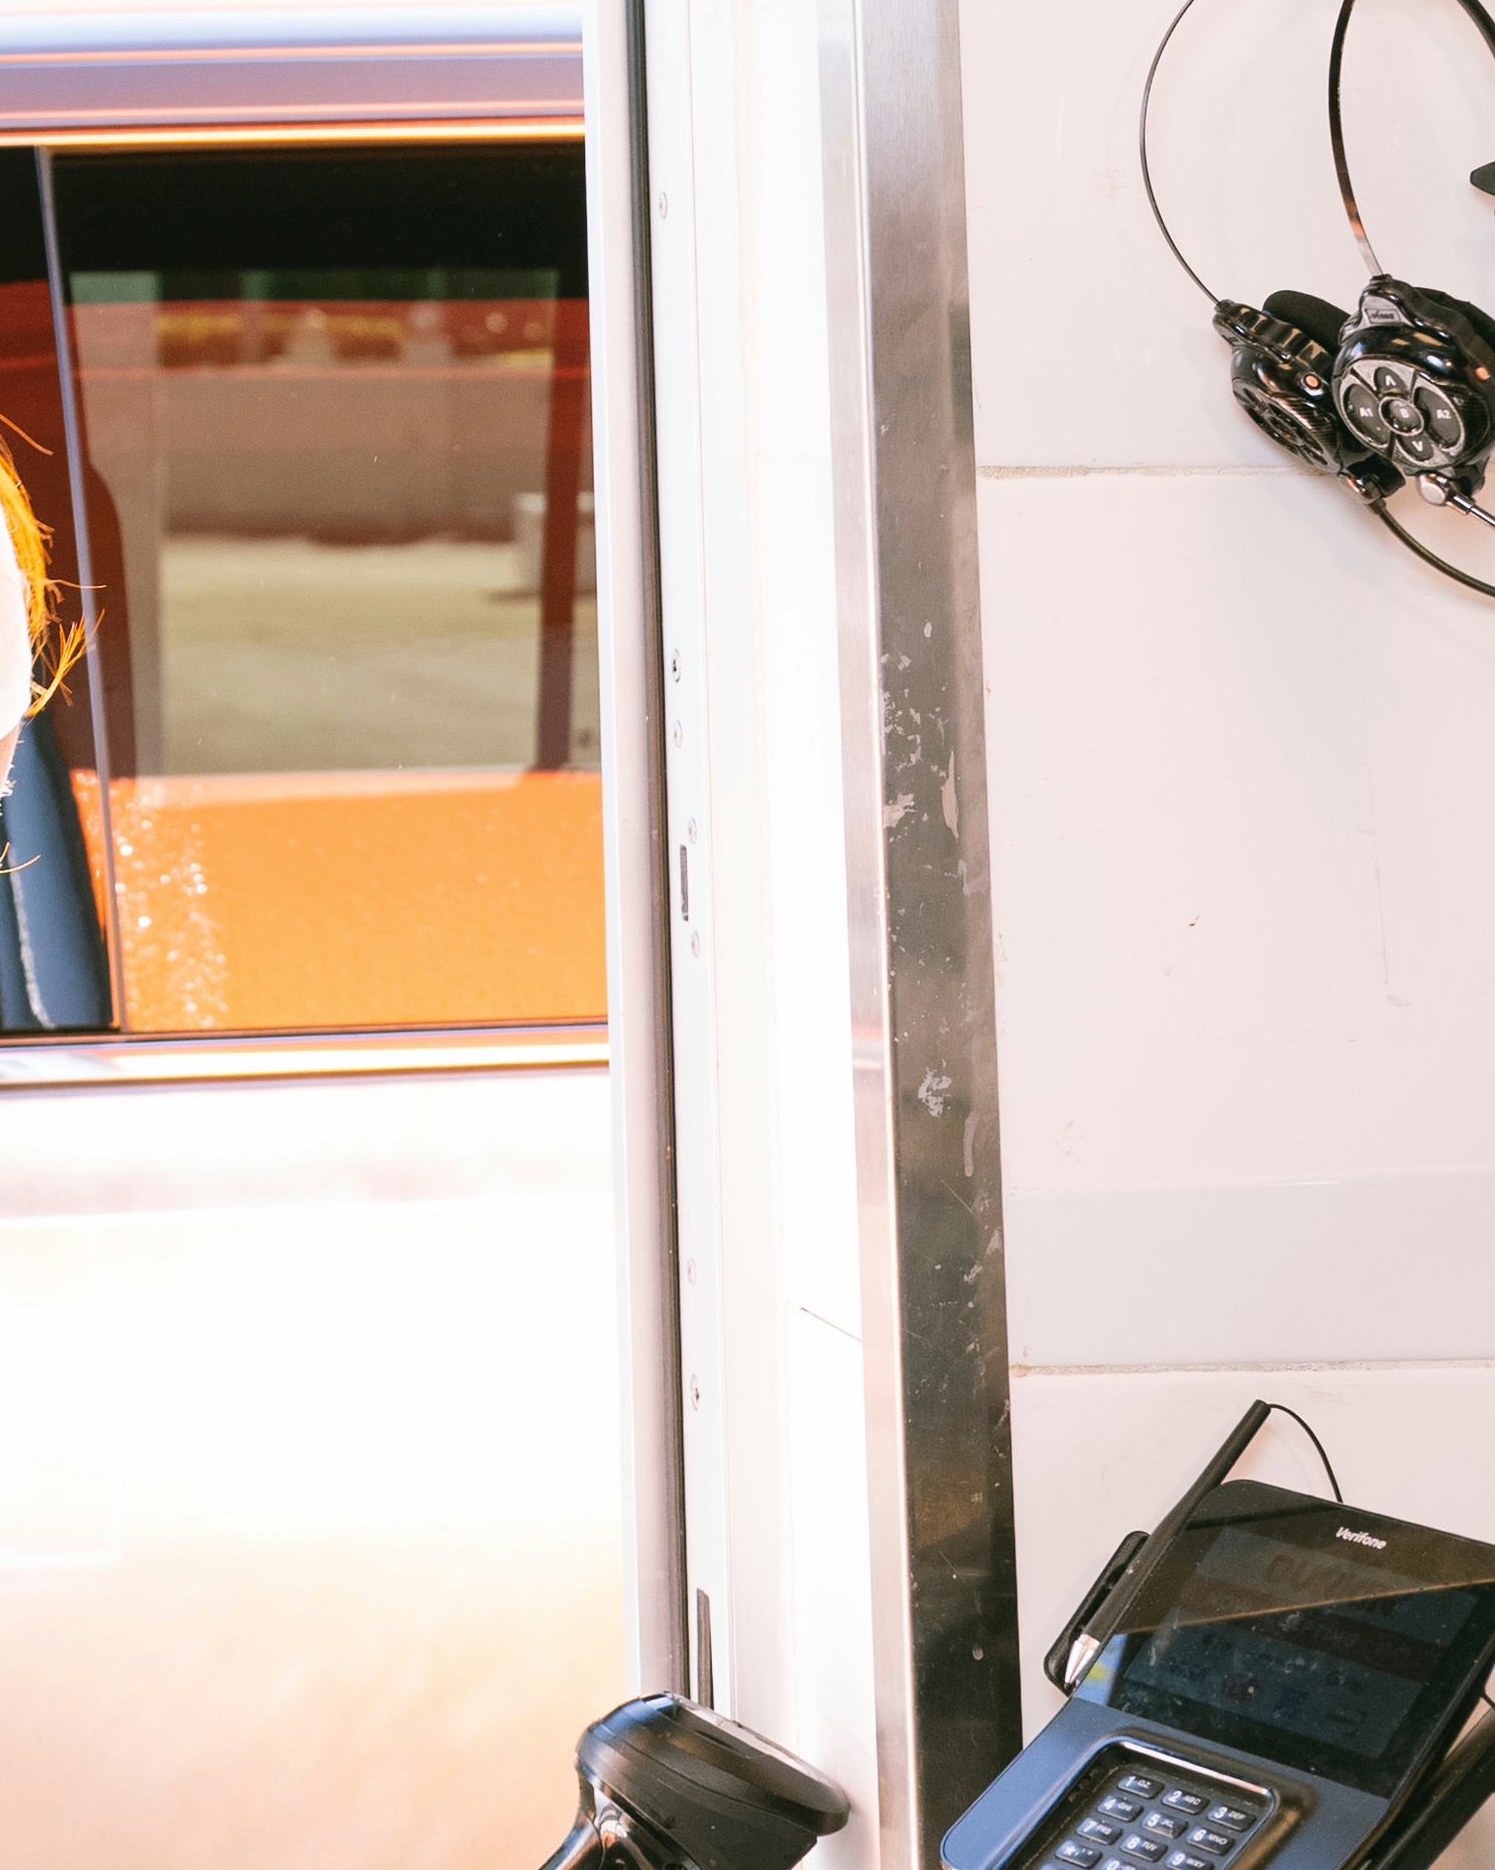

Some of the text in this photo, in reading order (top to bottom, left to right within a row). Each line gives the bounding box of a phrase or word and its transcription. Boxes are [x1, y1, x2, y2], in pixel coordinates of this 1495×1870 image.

[1335, 1526, 1388, 1550] Verifone
[1126, 1775, 1137, 1787] 1
[1170, 1790, 1183, 1803] 2
[1104, 1798, 1117, 1810] 4
[1215, 1806, 1228, 1818] 3
[1148, 1814, 1160, 1826] 5
[1084, 1821, 1097, 1832] 7
[1193, 1828, 1204, 1841] 6
[1128, 1836, 1140, 1849] 8
[1174, 1852, 1186, 1864] 9
